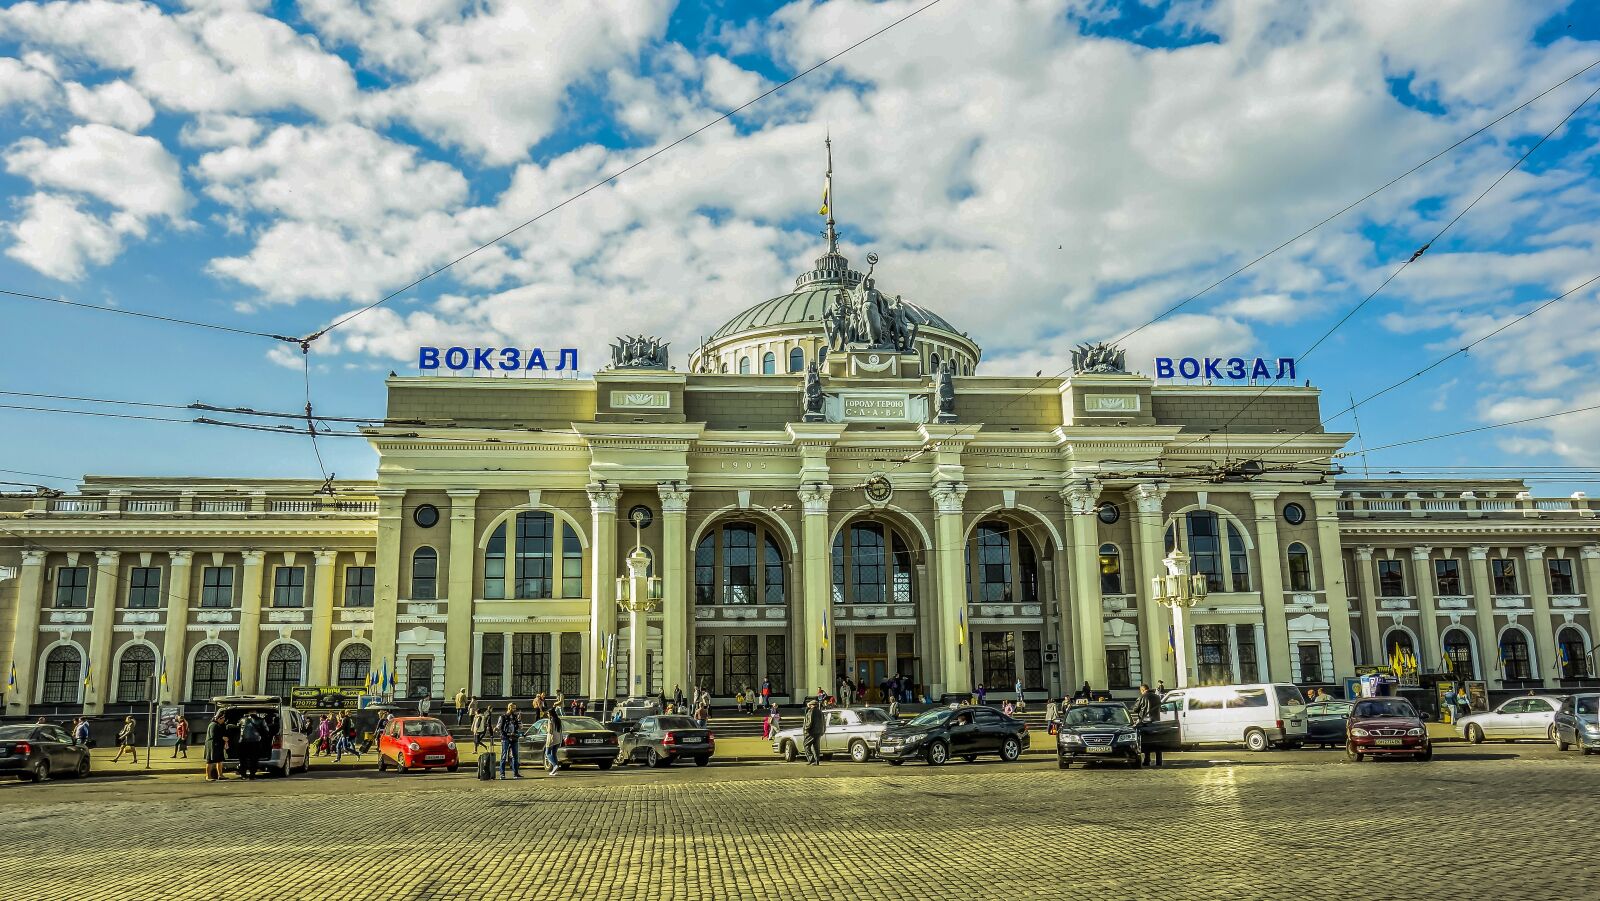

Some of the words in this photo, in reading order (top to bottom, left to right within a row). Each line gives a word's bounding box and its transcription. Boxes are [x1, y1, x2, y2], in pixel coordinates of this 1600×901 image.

[418, 346, 578, 371] ВОКЗАЛ
[1154, 357, 1296, 380] ВОКЗАЛ
[721, 461, 766, 469] 1905
